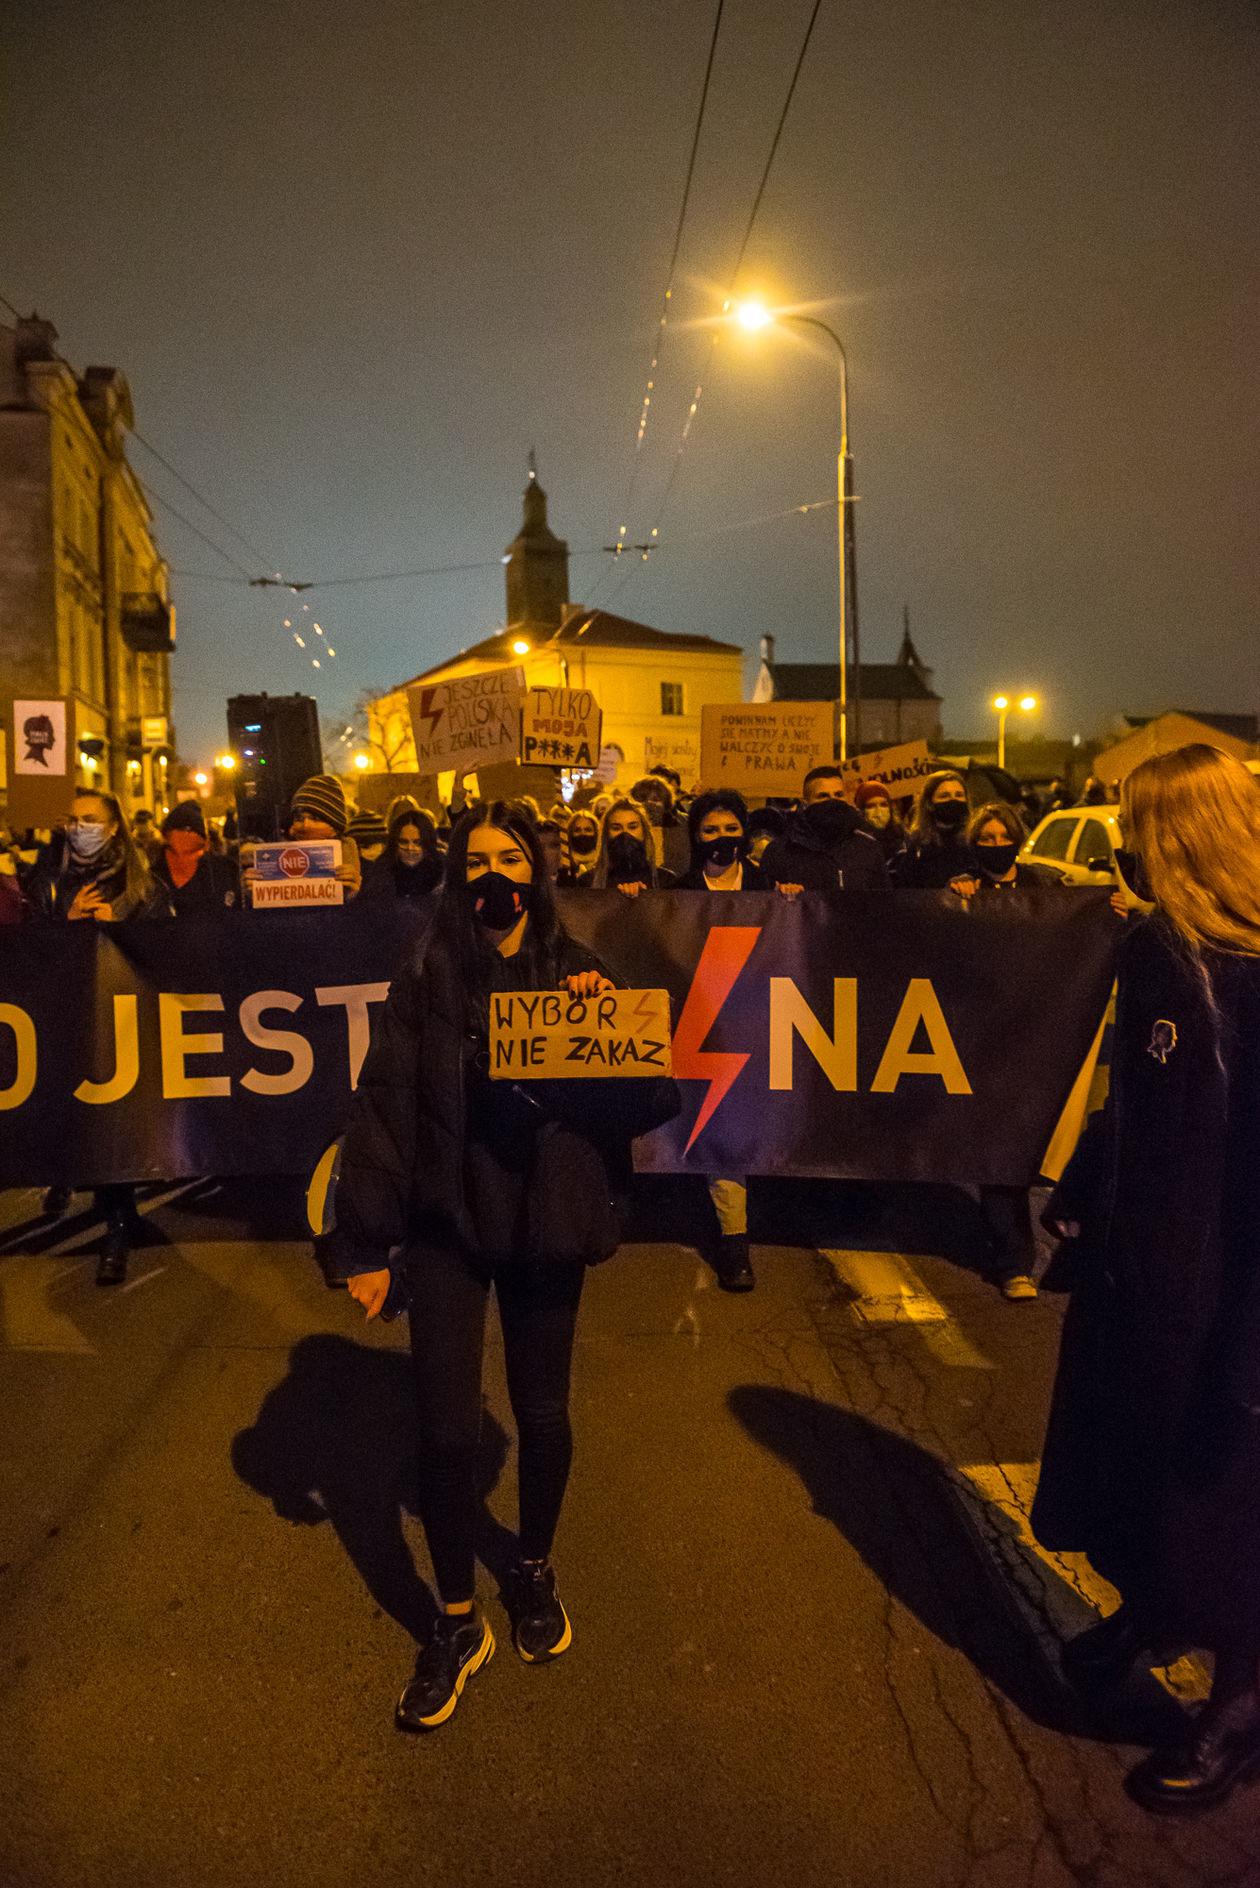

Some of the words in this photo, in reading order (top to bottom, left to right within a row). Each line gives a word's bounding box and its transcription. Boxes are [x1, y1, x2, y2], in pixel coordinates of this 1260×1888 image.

[532, 688, 592, 720] TYLKO
[532, 718, 588, 738] MOJA
[420, 738, 445, 760] NIE
[744, 755, 796, 771] PRAWA
[282, 856, 306, 870] NIE
[255, 880, 336, 901] WYPIERDALAĆ!
[73, 981, 391, 1104] JEST
[496, 1036, 547, 1068] NIE
[565, 1036, 667, 1067] ZAKAZ
